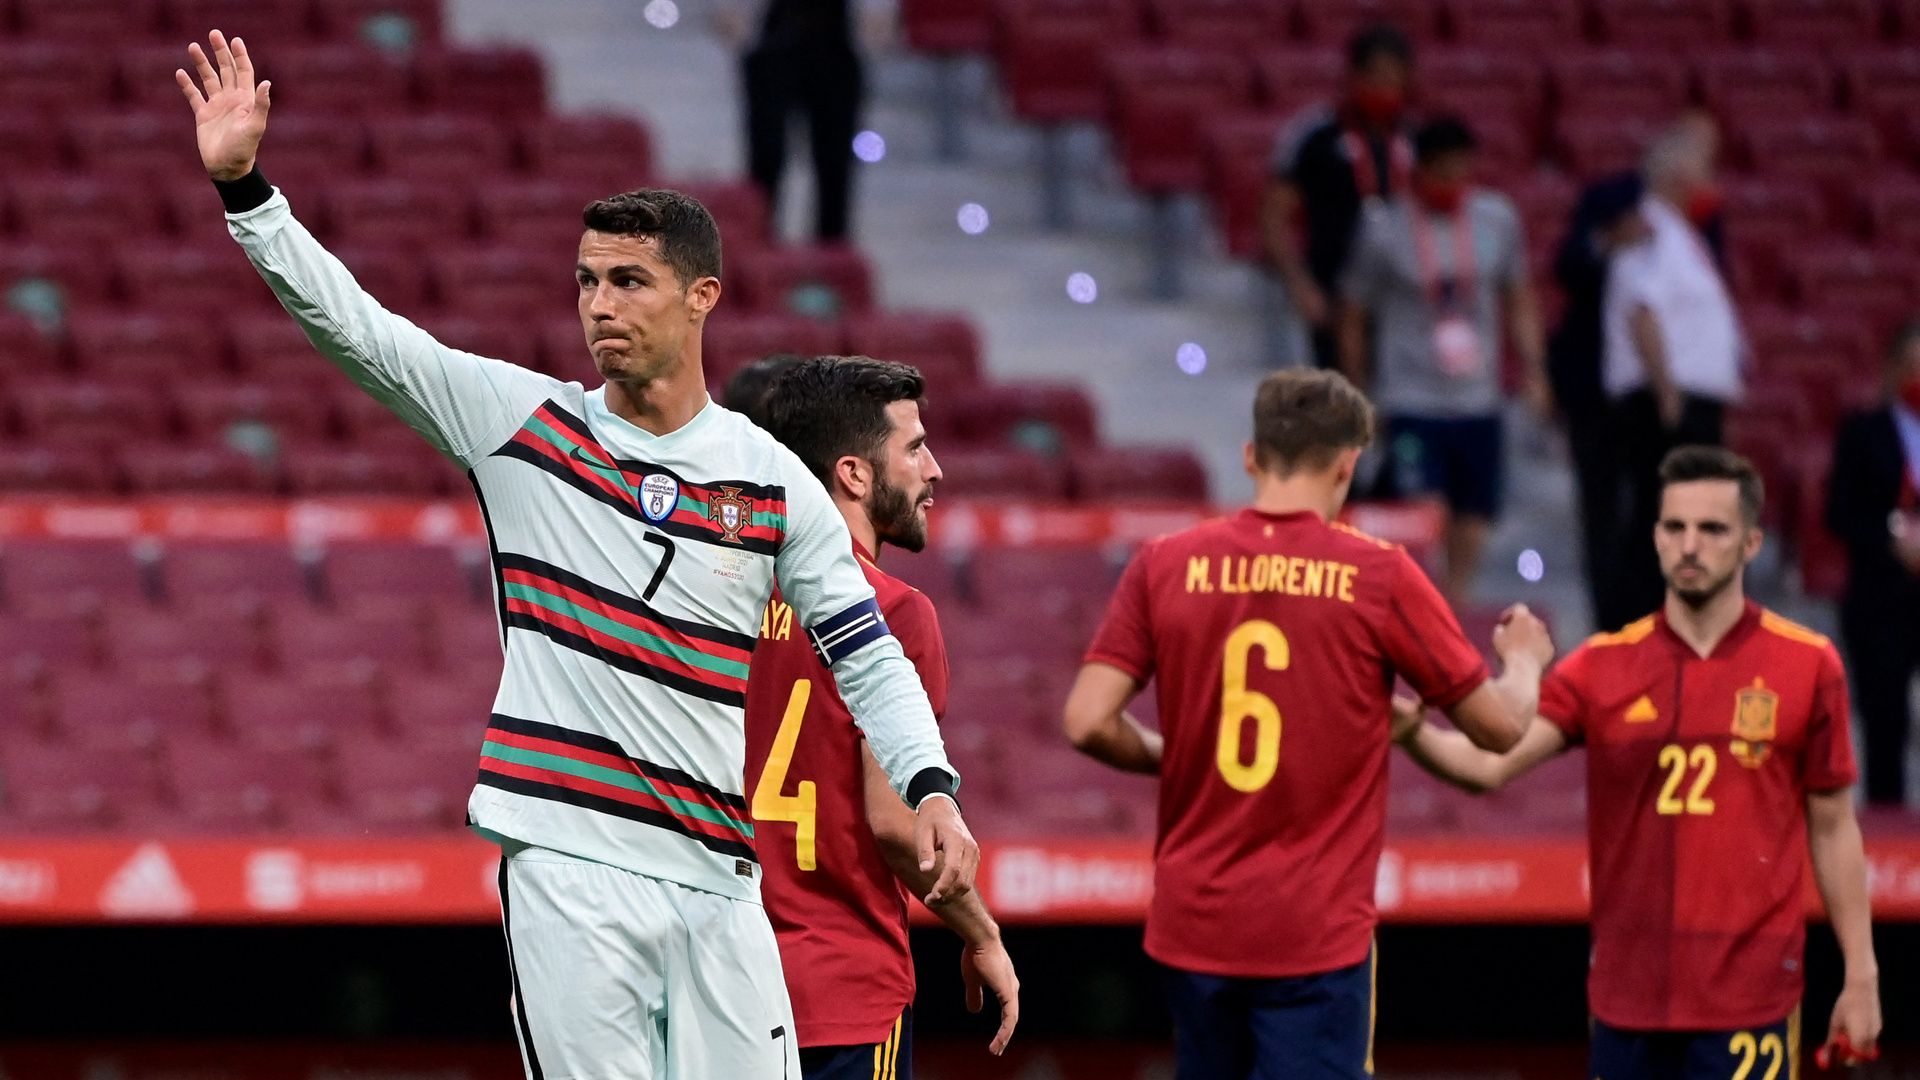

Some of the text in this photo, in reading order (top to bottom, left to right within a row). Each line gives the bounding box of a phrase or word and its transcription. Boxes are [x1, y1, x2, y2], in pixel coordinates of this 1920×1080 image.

[644, 483, 675, 492] EUROPEAN
[644, 488, 674, 496] CHAMPIONS
[652, 475, 670, 485] UEFA
[642, 531, 676, 602] 7
[1185, 554, 1359, 603] M. LLORENTE
[1216, 619, 1290, 793] 6
[751, 679, 817, 872] 4
[1656, 743, 1718, 815] 22
